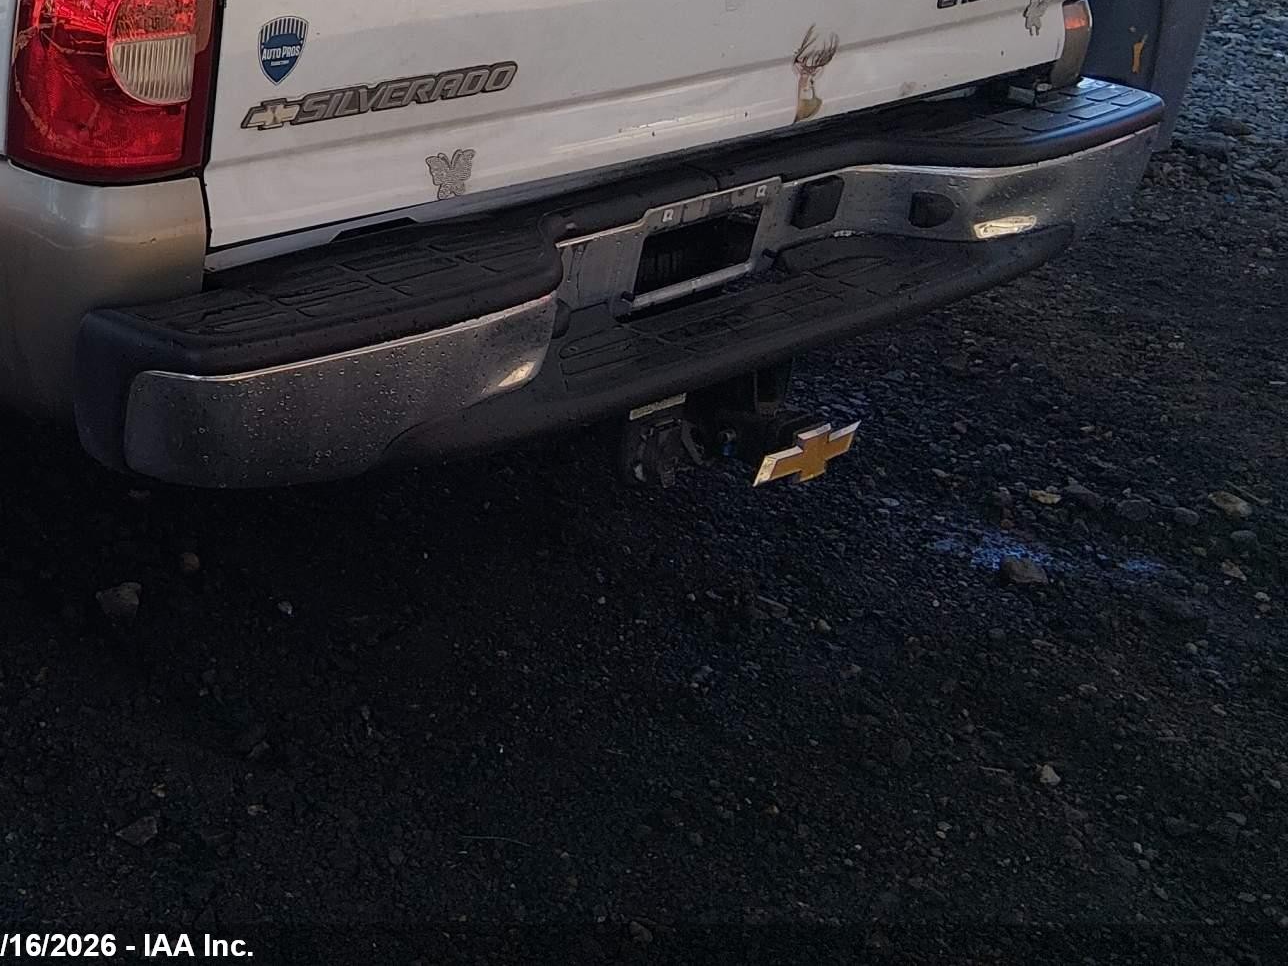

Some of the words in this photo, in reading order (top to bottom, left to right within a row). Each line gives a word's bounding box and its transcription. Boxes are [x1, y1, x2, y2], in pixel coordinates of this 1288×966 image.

[262, 47, 282, 61] AUTO
[282, 45, 301, 58] PROS
[298, 62, 517, 123] SILVERADO
